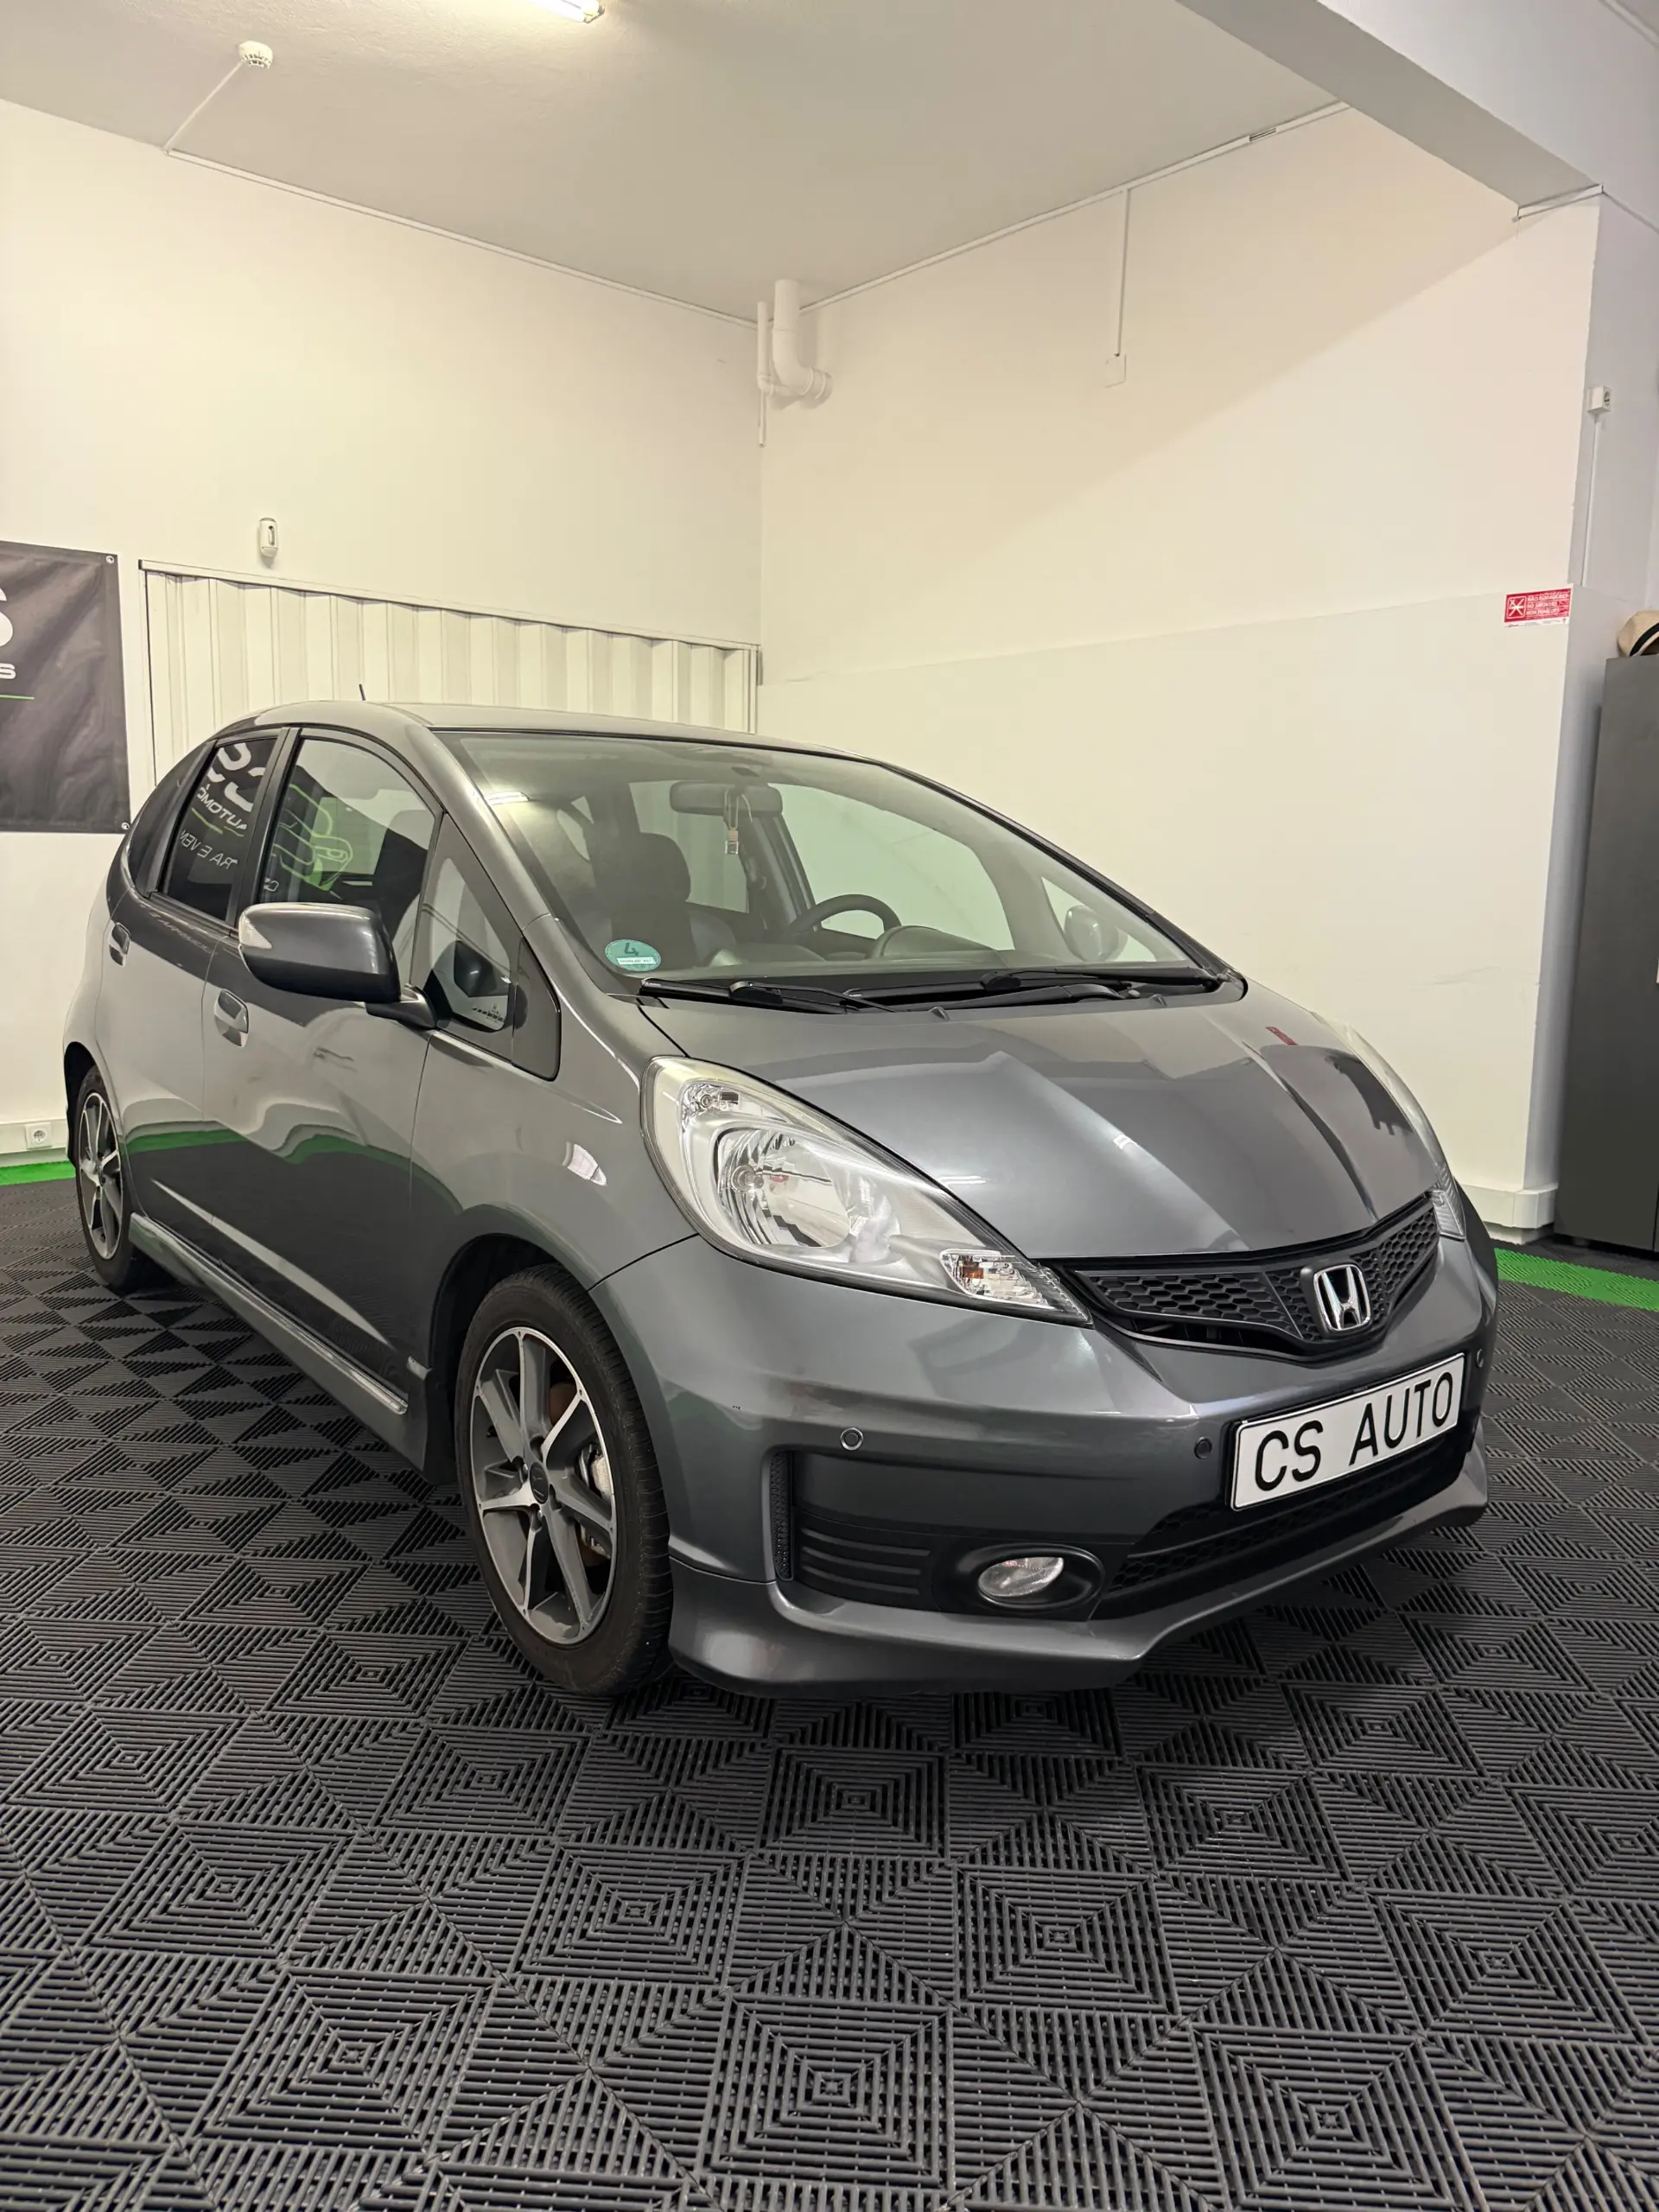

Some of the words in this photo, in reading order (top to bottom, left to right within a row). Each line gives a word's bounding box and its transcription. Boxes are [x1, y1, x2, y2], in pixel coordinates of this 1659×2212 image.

[624, 942, 639, 957] 4
[1255, 1420, 1324, 1491] CS
[1348, 1371, 1453, 1466] AUTO
